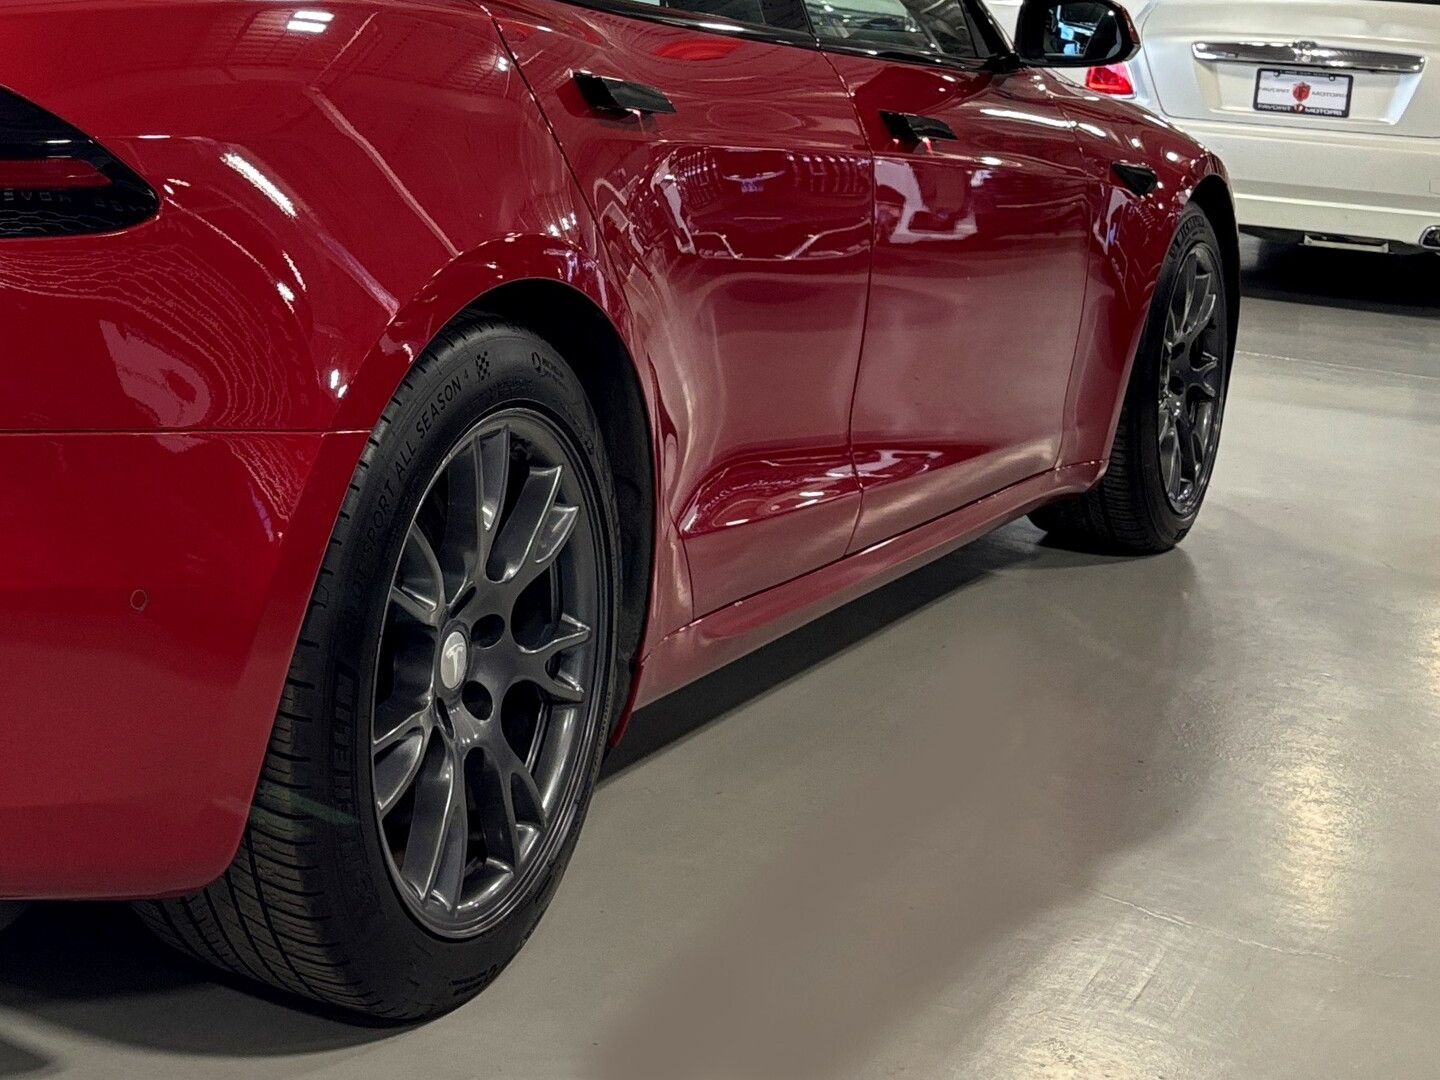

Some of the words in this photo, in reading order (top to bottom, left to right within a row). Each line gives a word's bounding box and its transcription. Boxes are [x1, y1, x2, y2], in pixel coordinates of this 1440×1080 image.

[363, 479, 395, 554] SPORT
[394, 441, 417, 481] ALL
[415, 375, 463, 439] SEASON
